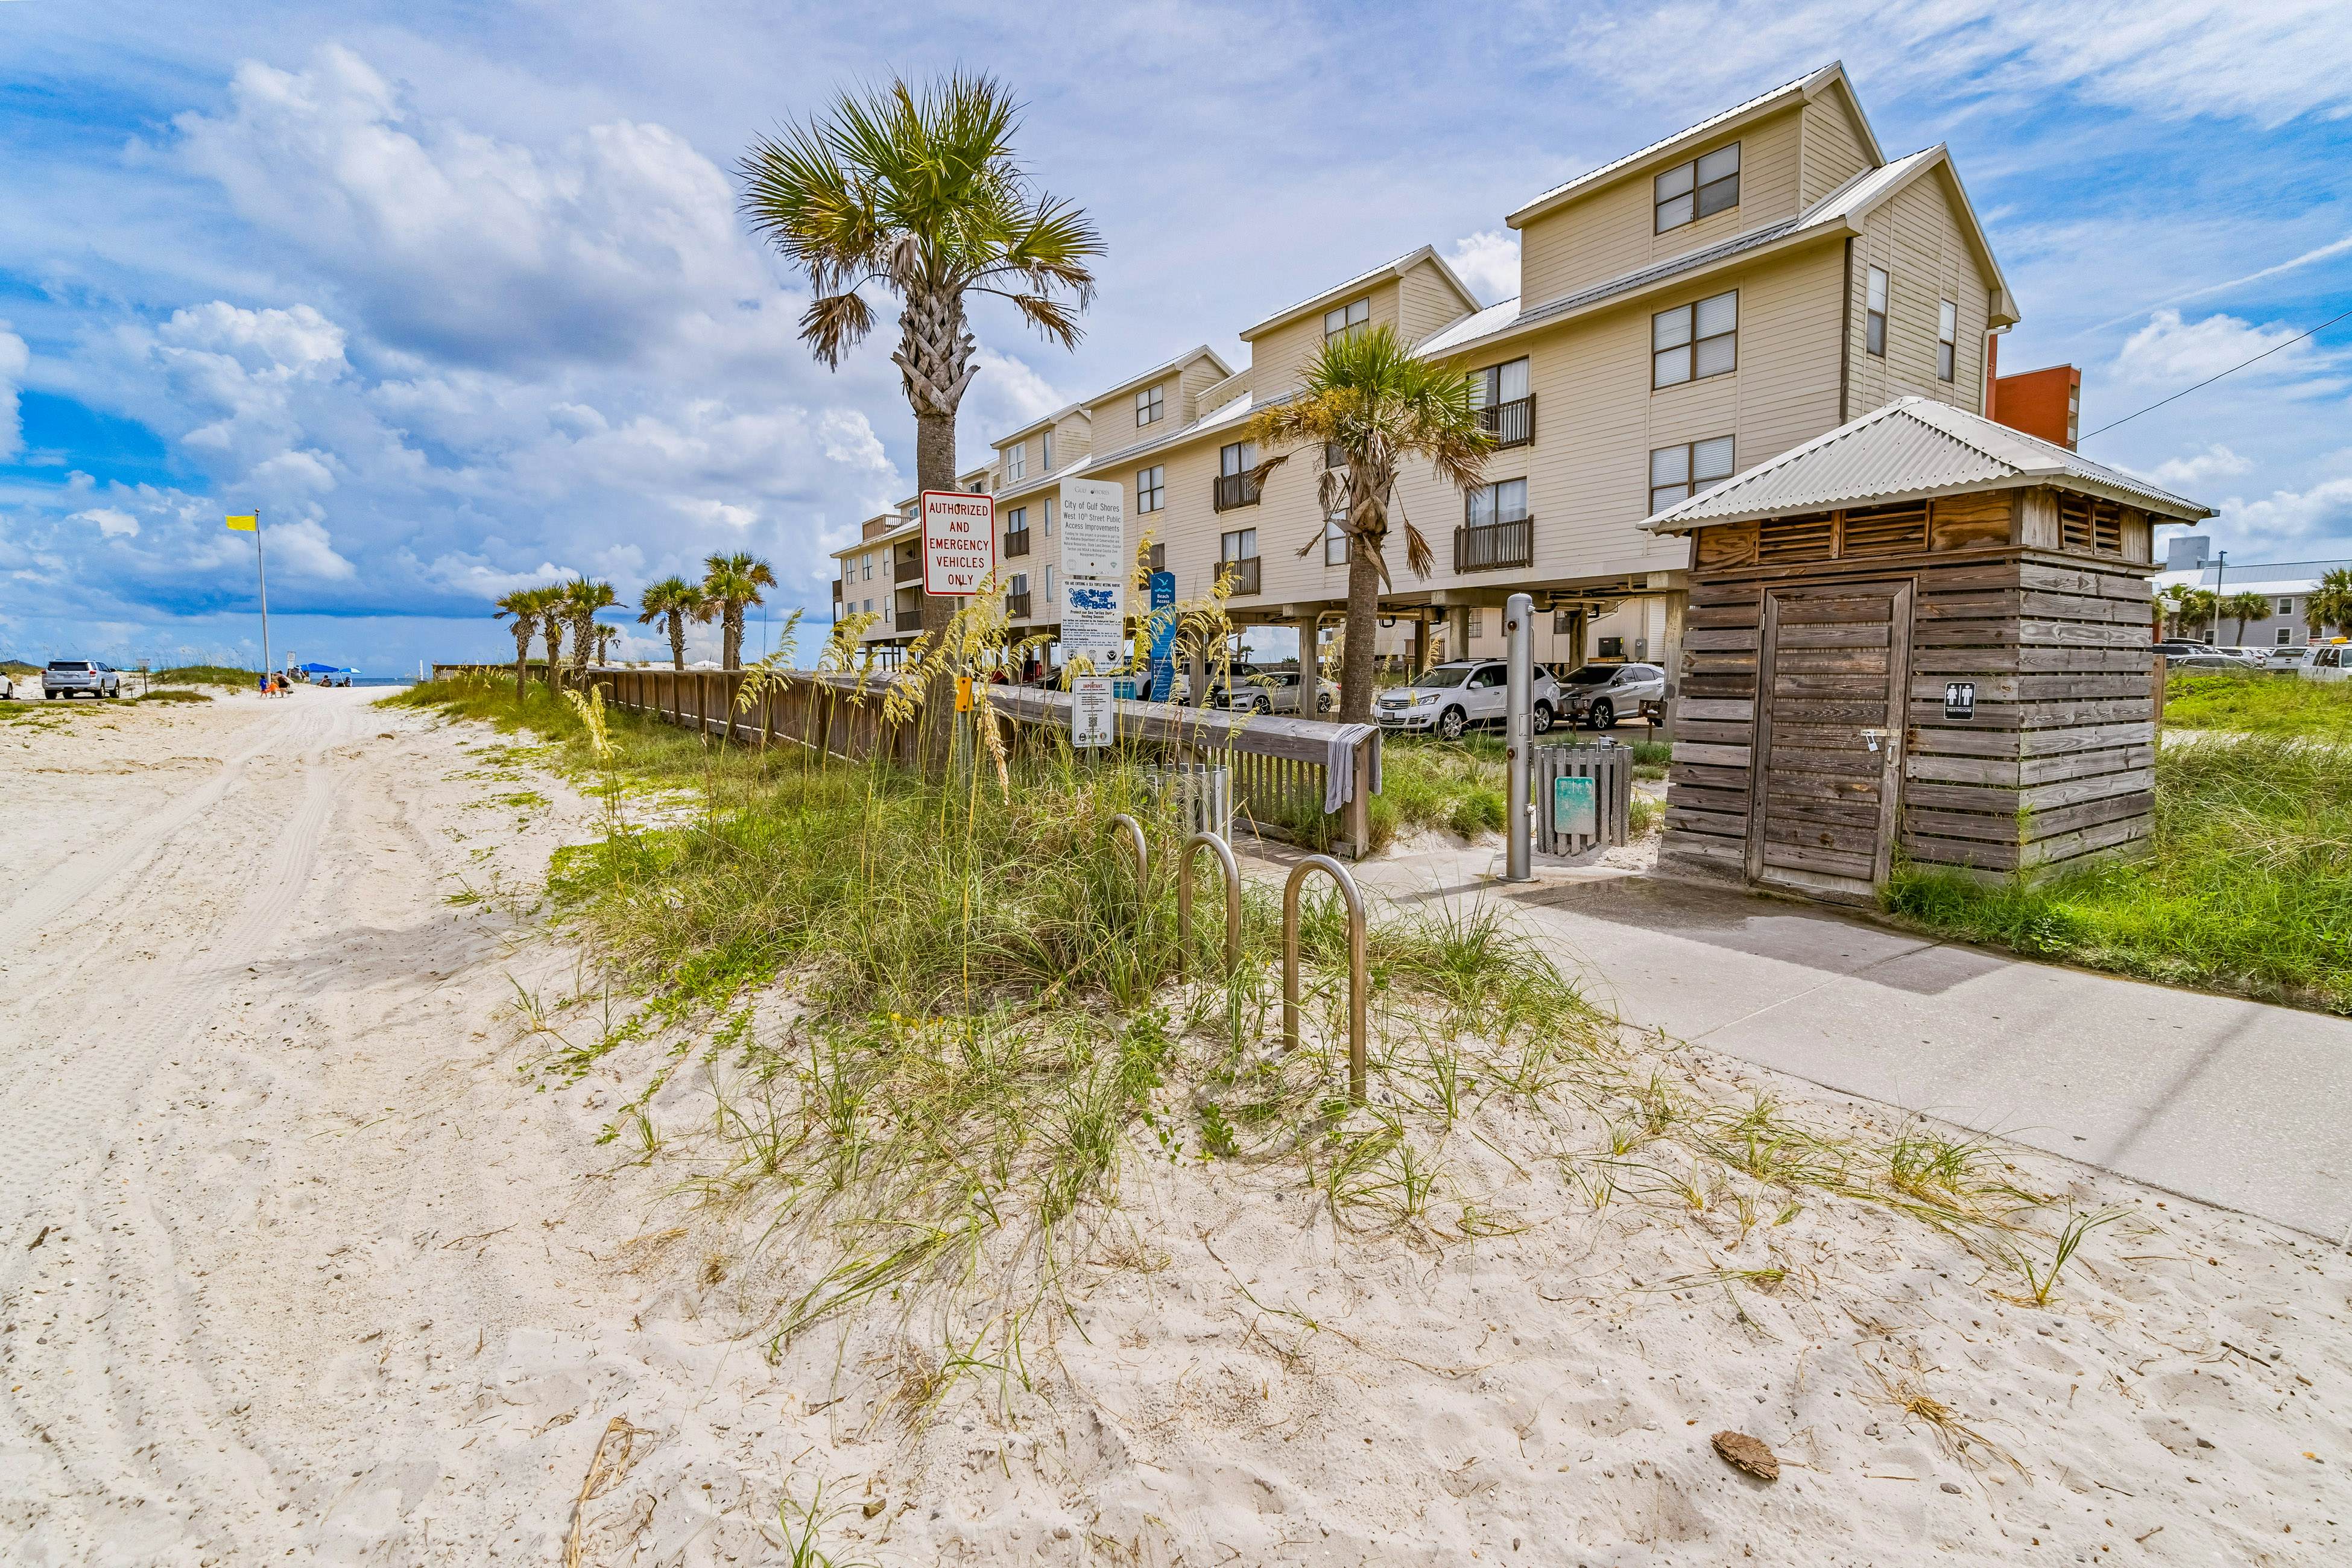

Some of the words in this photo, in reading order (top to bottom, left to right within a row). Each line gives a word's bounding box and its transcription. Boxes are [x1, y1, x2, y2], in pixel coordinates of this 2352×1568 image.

[929, 502, 988, 516] AUTHORIZED
[1064, 500, 1076, 510] City
[1078, 501, 1084, 510] of
[1087, 502, 1098, 510] Gulf
[1100, 503, 1119, 512] Shores
[949, 522, 970, 533] AND
[1065, 521, 1083, 530] Access
[1085, 523, 1119, 532] Improvements
[929, 538, 988, 551] EMERGENCY
[937, 556, 984, 568] VEHICLES
[948, 574, 973, 585] ONLY
